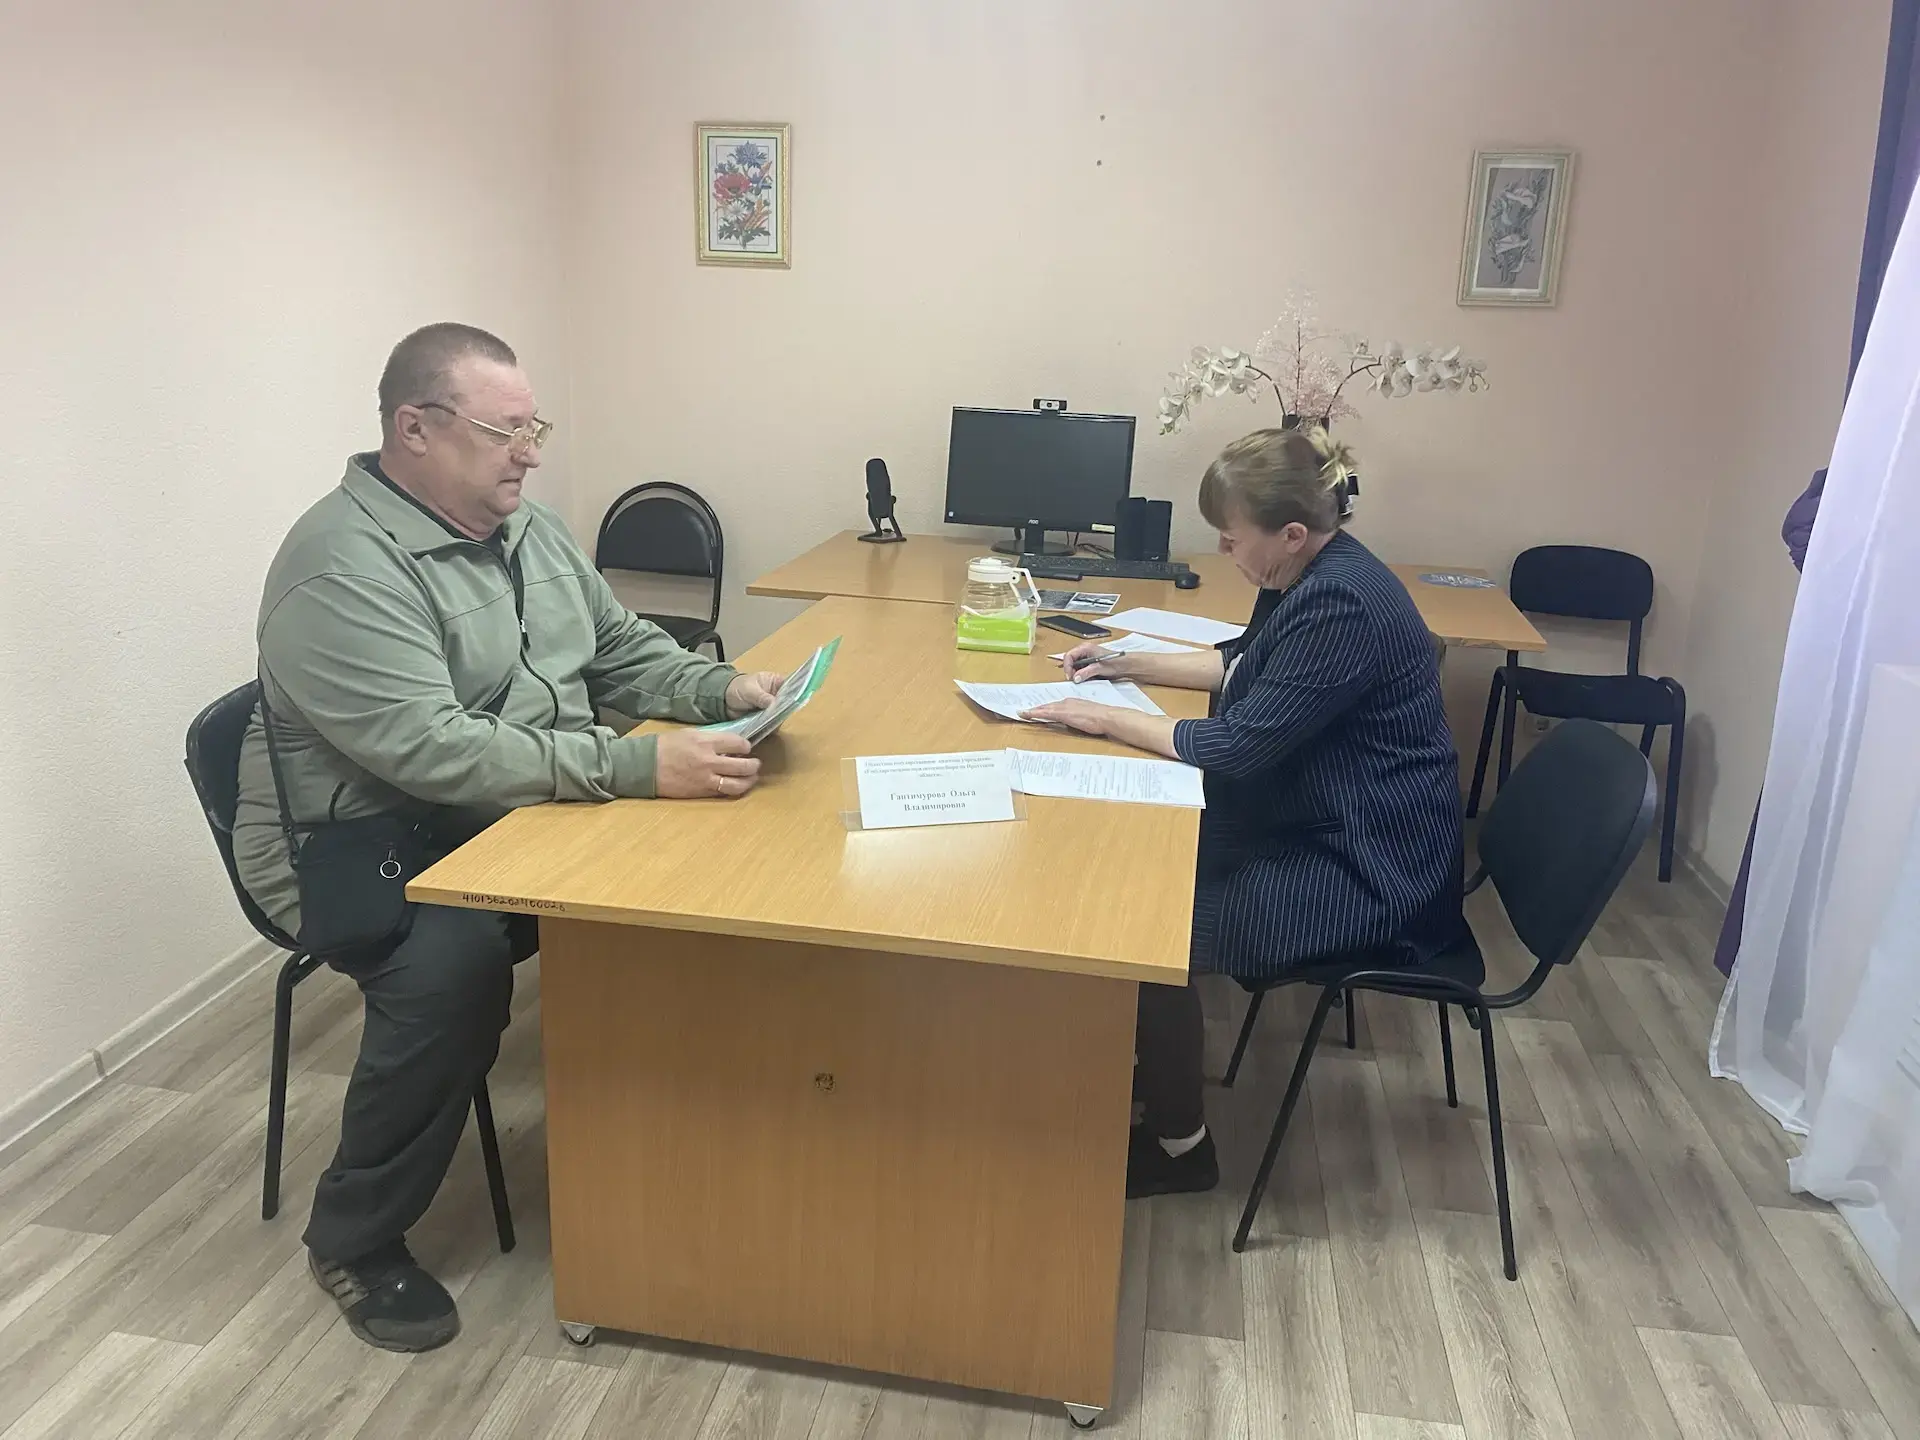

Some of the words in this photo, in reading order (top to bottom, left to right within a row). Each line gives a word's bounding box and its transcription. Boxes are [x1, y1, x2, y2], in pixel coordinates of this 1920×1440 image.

[890, 792, 946, 801] Гантимурова
[950, 789, 976, 797] Ольга
[904, 802, 966, 811] Владимировна
